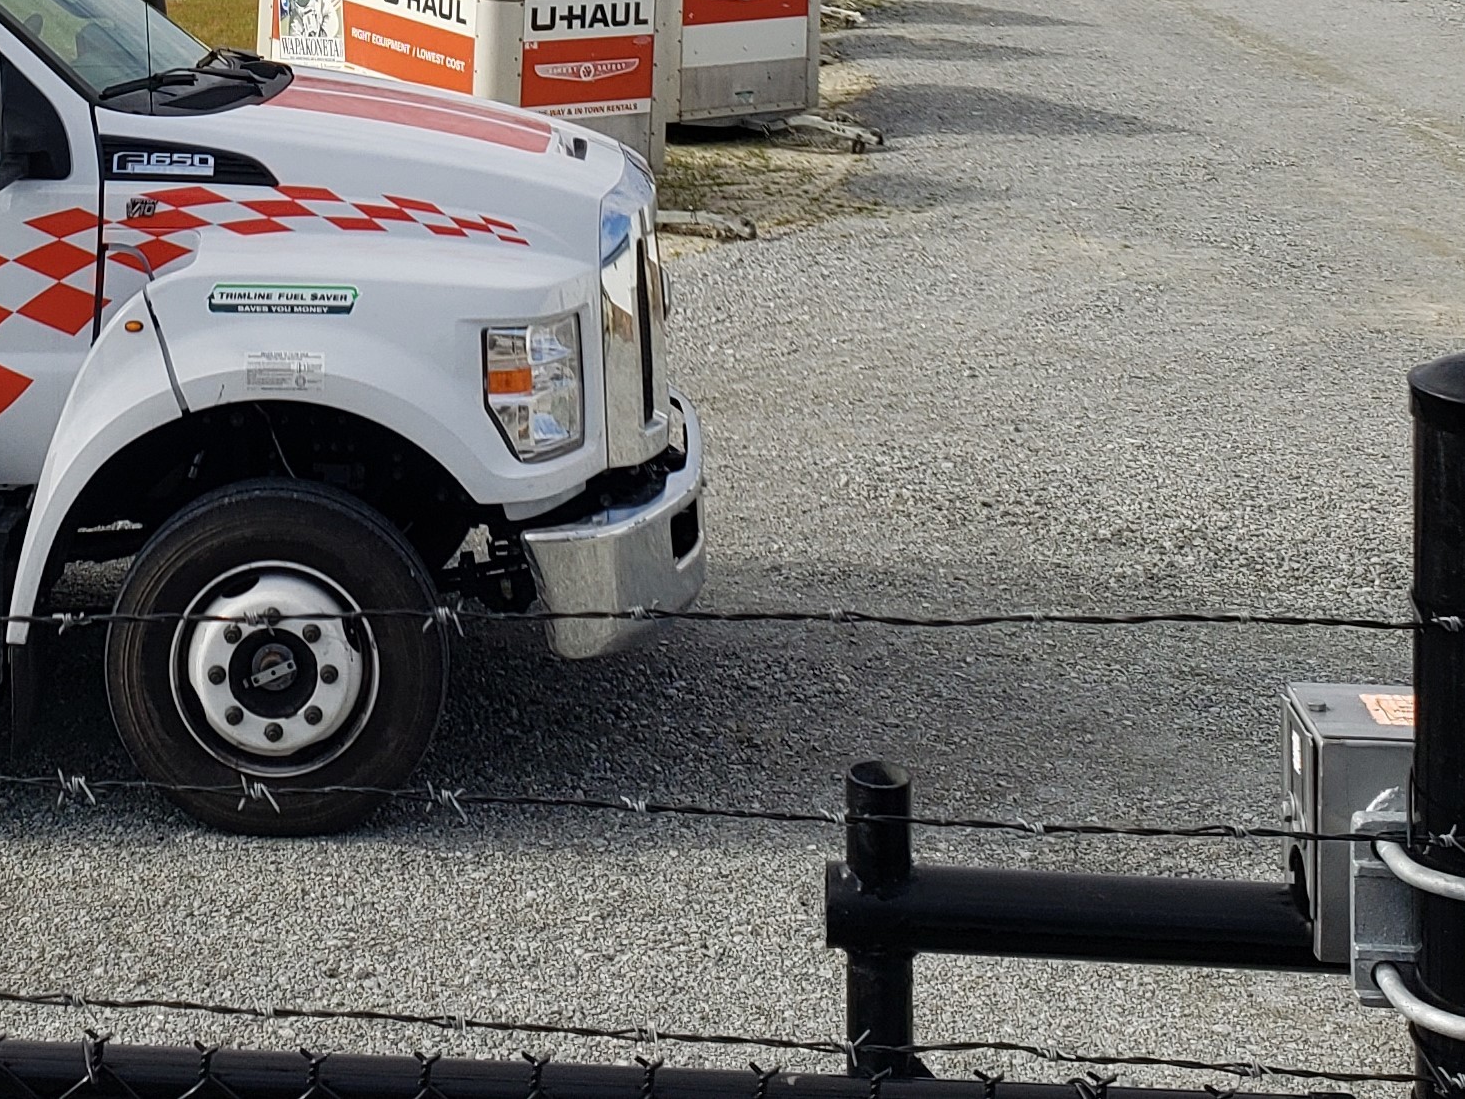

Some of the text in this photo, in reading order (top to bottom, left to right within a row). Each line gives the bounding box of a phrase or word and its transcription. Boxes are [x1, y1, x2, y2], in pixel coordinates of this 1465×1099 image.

[530, 1, 649, 32] U-HAUL
[281, 37, 340, 58] WAPAKONETA
[351, 26, 371, 43] RIGHT
[371, 33, 411, 55] EQUIPMENT
[416, 46, 445, 66] LOWEST
[445, 56, 466, 72] COST
[606, 102, 638, 112] RENTALS
[218, 291, 348, 302] TRIMLINE FUEL SAVER
[237, 305, 269, 313] SAVES
[270, 305, 291, 313] YOU
